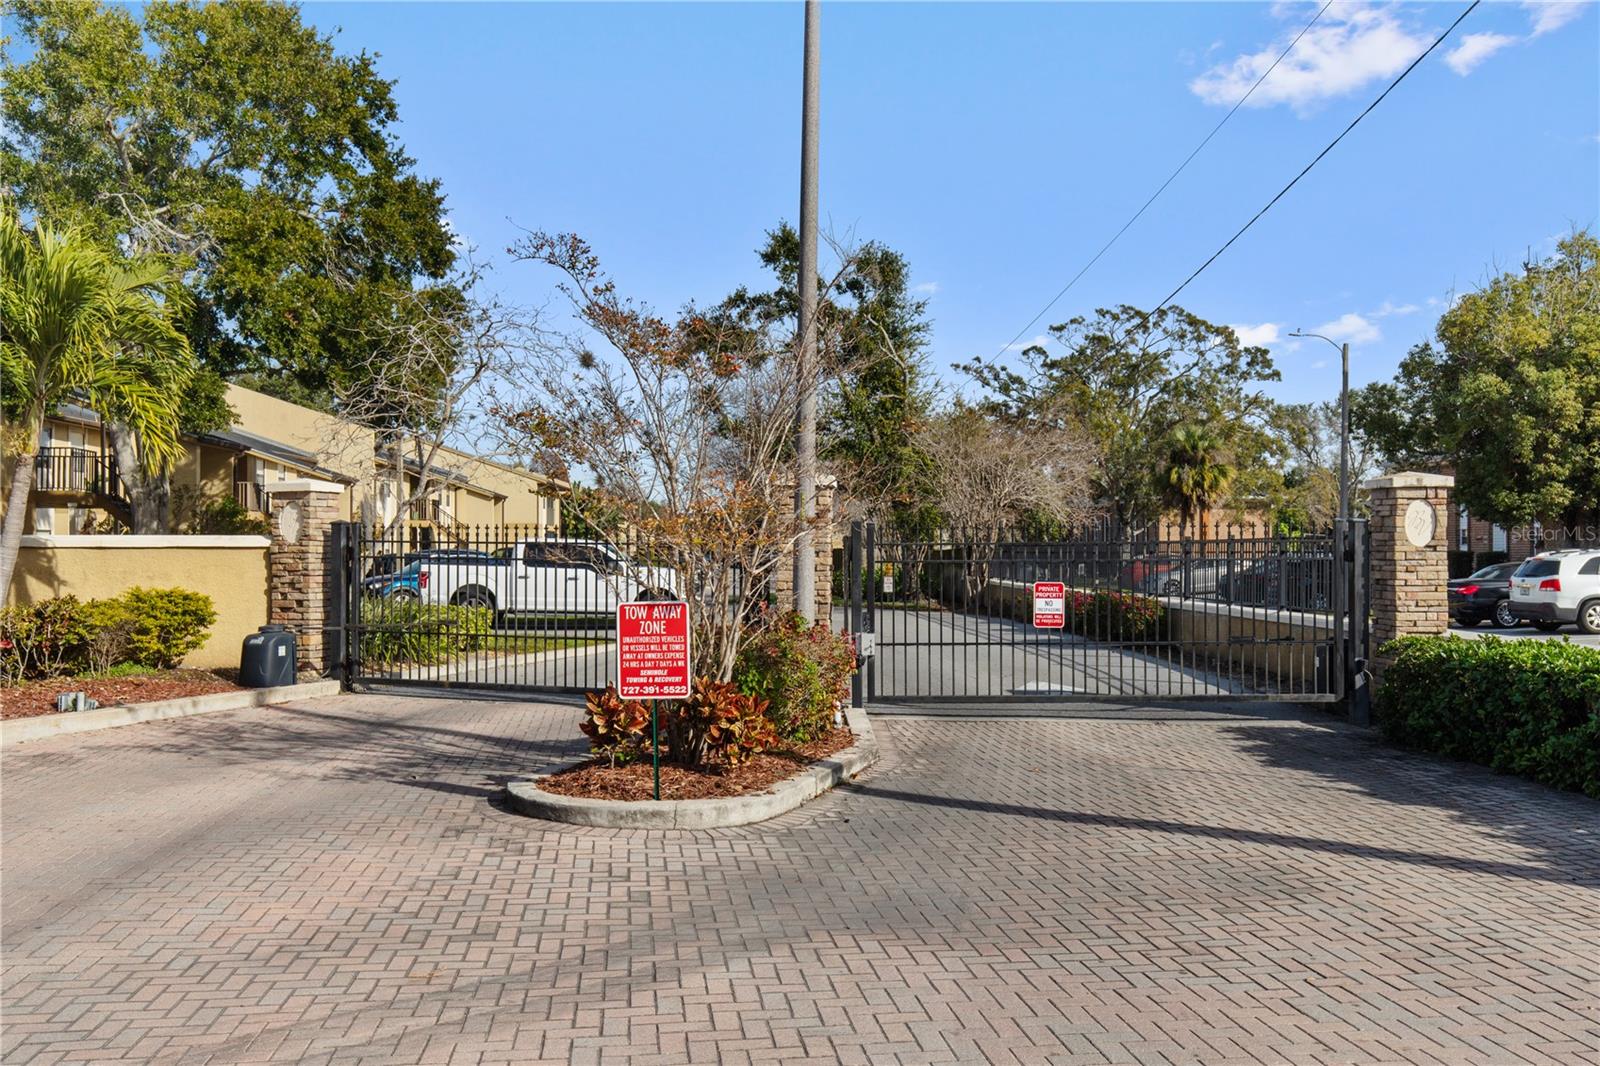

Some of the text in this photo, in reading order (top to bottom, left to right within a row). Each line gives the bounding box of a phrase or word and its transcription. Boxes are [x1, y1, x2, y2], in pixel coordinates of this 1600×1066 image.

[624, 606, 682, 619] TOW AWAY
[640, 621, 666, 634] ZONE
[622, 686, 686, 694] 727-391-5522
